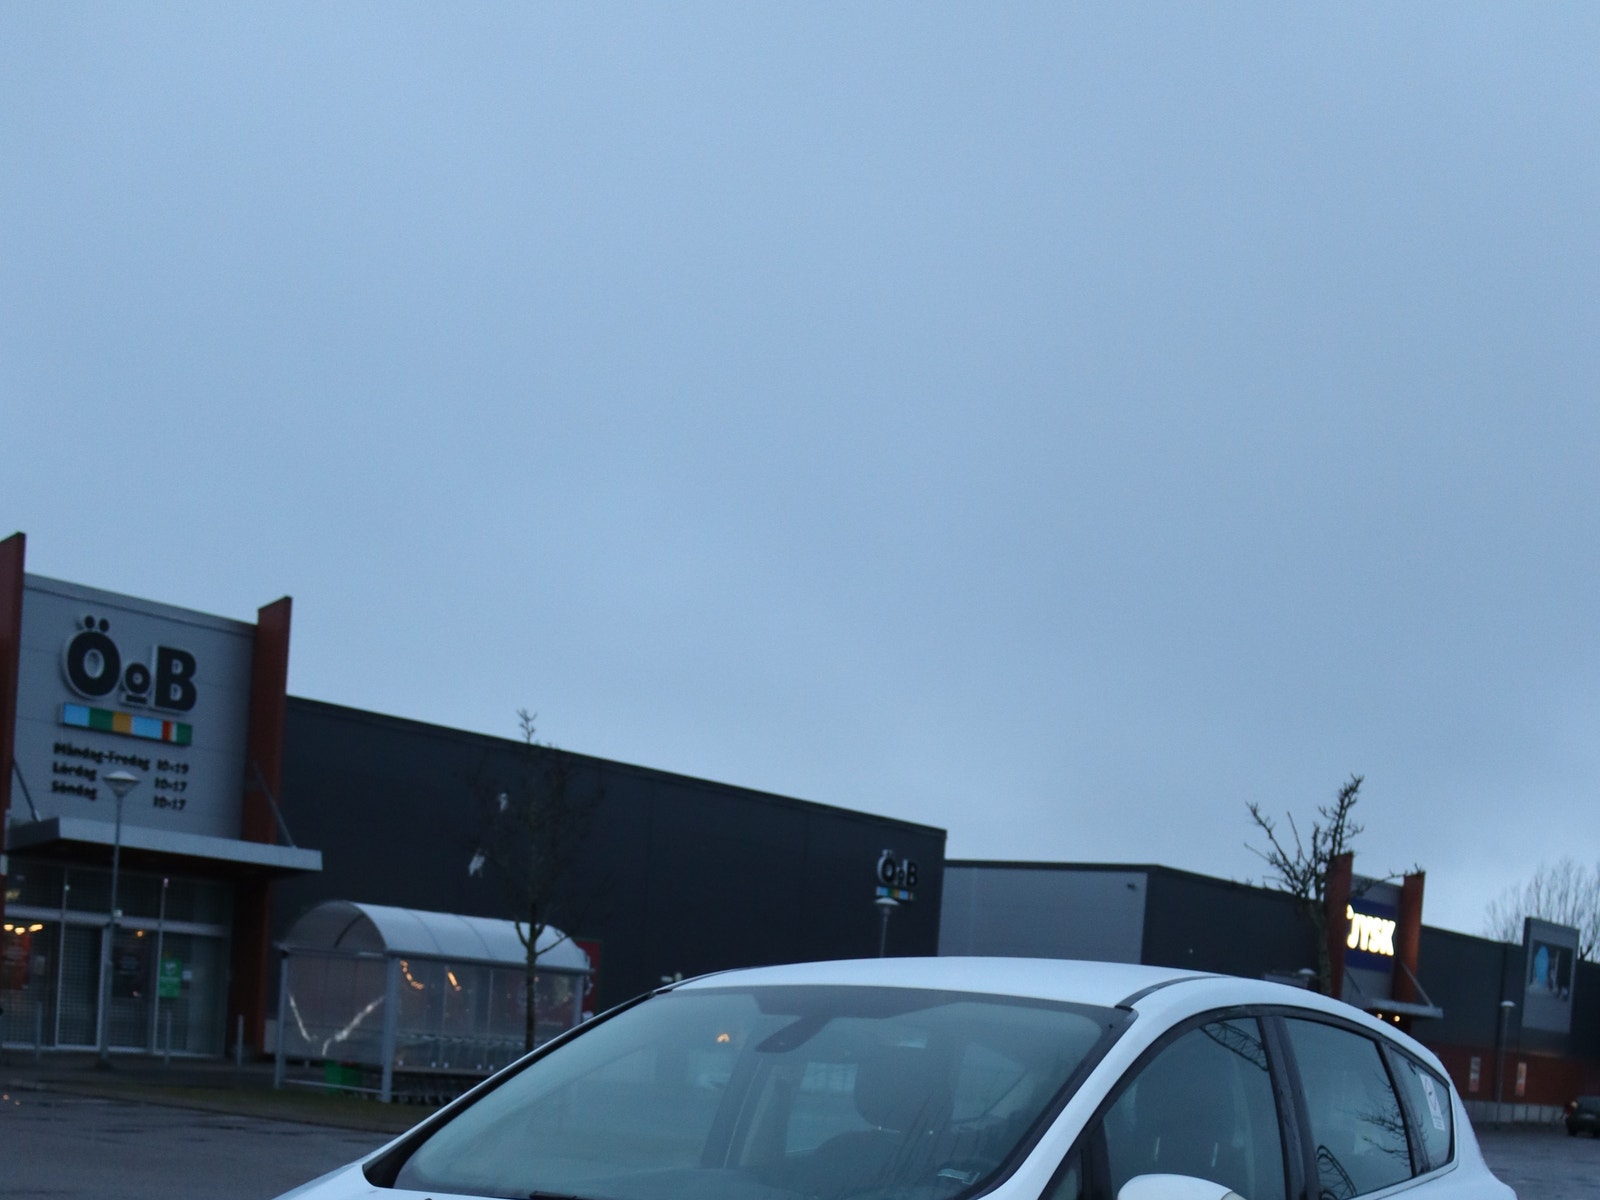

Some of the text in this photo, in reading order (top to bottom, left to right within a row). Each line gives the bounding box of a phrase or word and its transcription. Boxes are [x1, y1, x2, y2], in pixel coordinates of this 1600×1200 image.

[53, 761, 187, 792] Lördag 10-17
[52, 780, 186, 810] Söndag 10-17
[1346, 912, 1396, 956] JYSK
